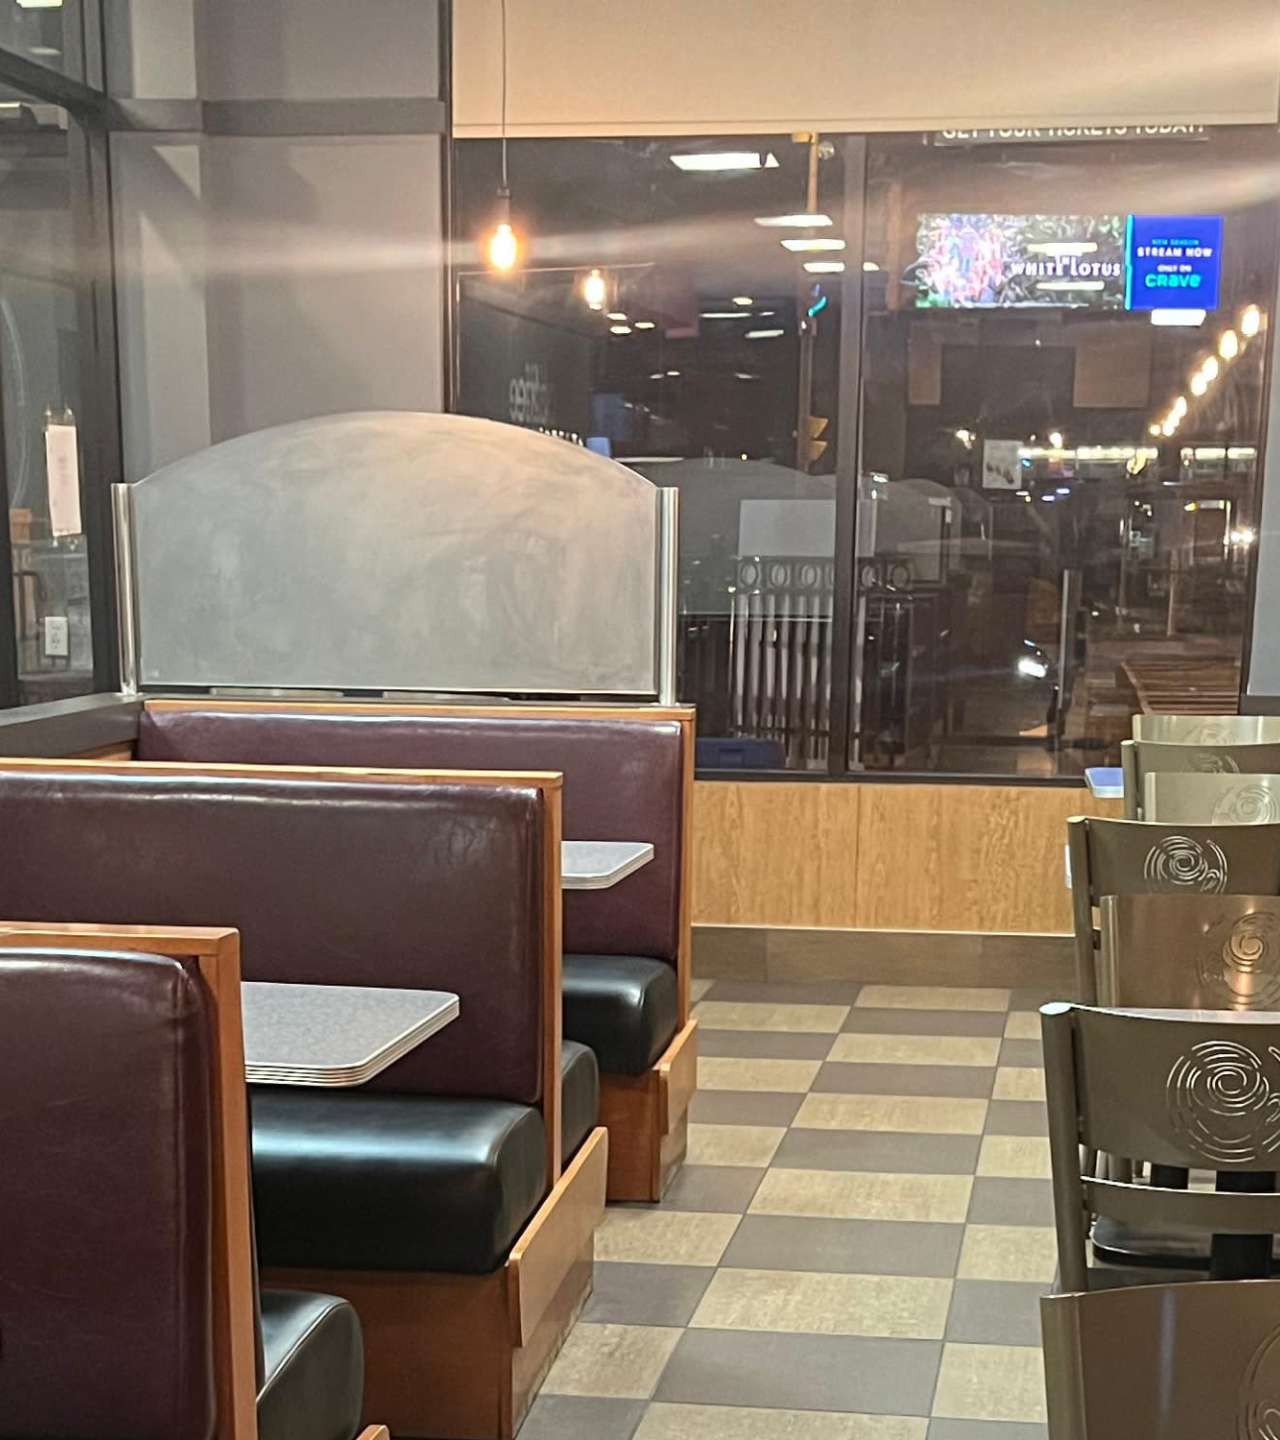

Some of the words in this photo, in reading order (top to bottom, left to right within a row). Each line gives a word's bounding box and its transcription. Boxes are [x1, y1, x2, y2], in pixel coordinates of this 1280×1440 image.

[1136, 246, 1183, 258] STREAM
[1185, 247, 1214, 258] NOW
[1070, 255, 1121, 277] LOTUS
